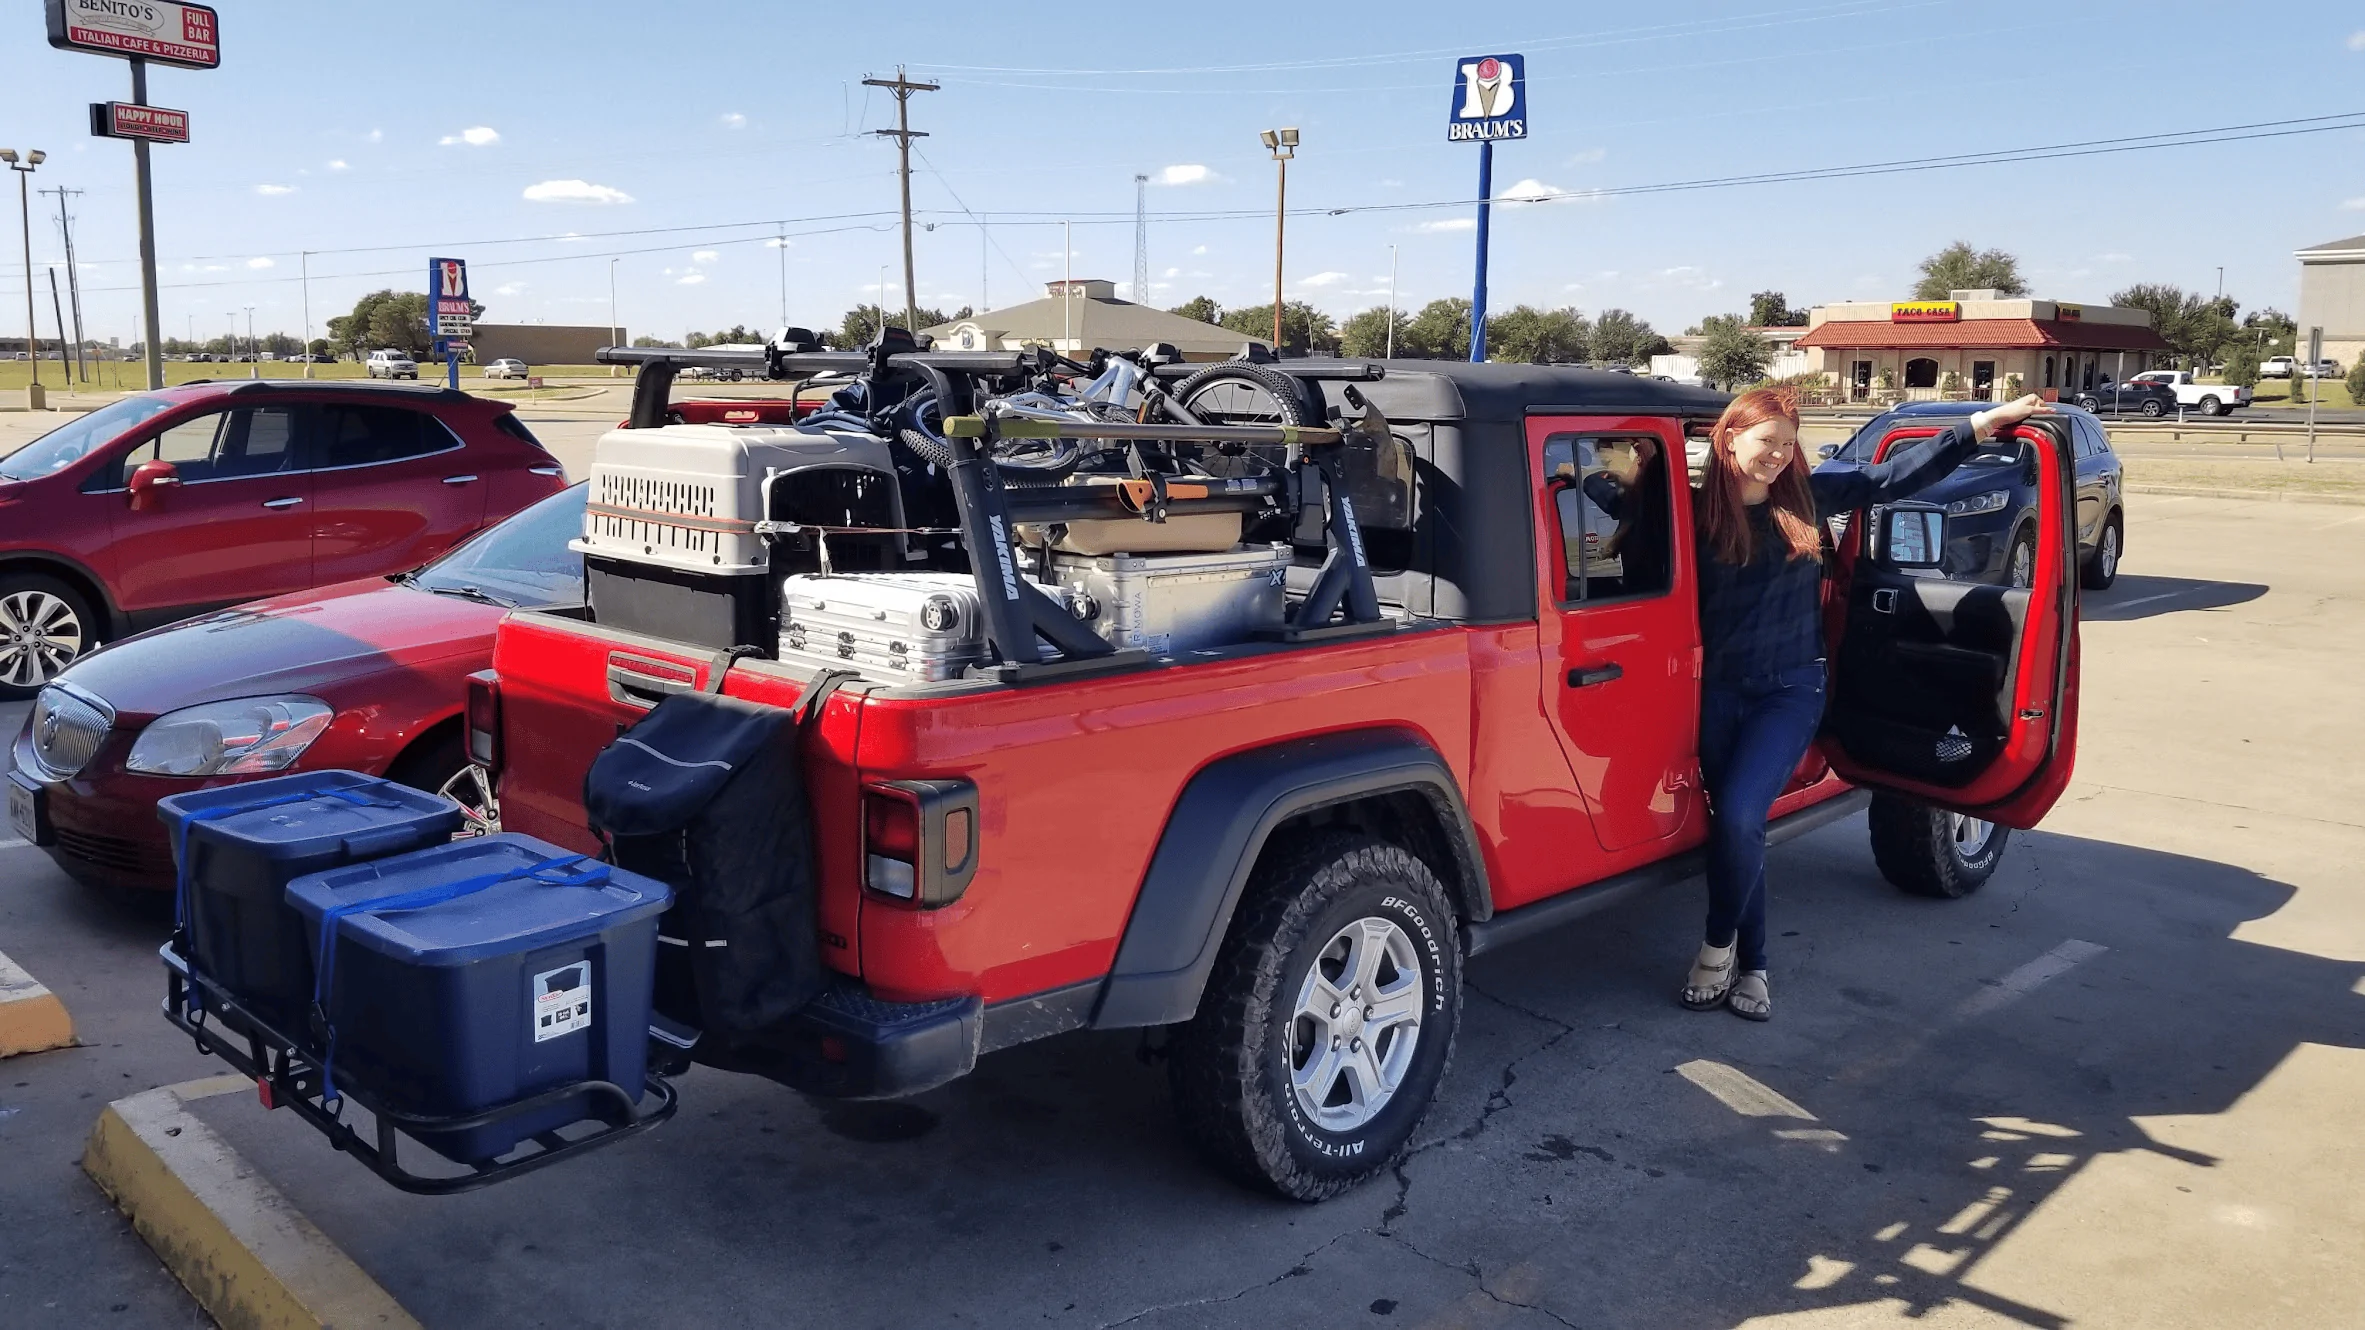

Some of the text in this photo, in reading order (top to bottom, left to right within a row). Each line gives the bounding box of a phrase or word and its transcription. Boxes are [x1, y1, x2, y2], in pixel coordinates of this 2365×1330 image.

[80, 0, 153, 20] BENITO'S
[186, 11, 210, 27] FULL
[77, 29, 210, 61] ITALIAN CAFE & PIZZERIA
[188, 27, 210, 42] BAR
[118, 107, 183, 127] HAPPY HOUR
[1449, 119, 1523, 140] BRAUM'S
[1896, 307, 1951, 317] TACO CASA
[1341, 496, 1366, 568] YAKIMA
[989, 514, 1020, 600] YAKIMA
[1133, 591, 1142, 641] RIMOWA
[1381, 896, 1445, 1011] BFGoodrich
[1284, 1083, 1366, 1157] All-Terrain
